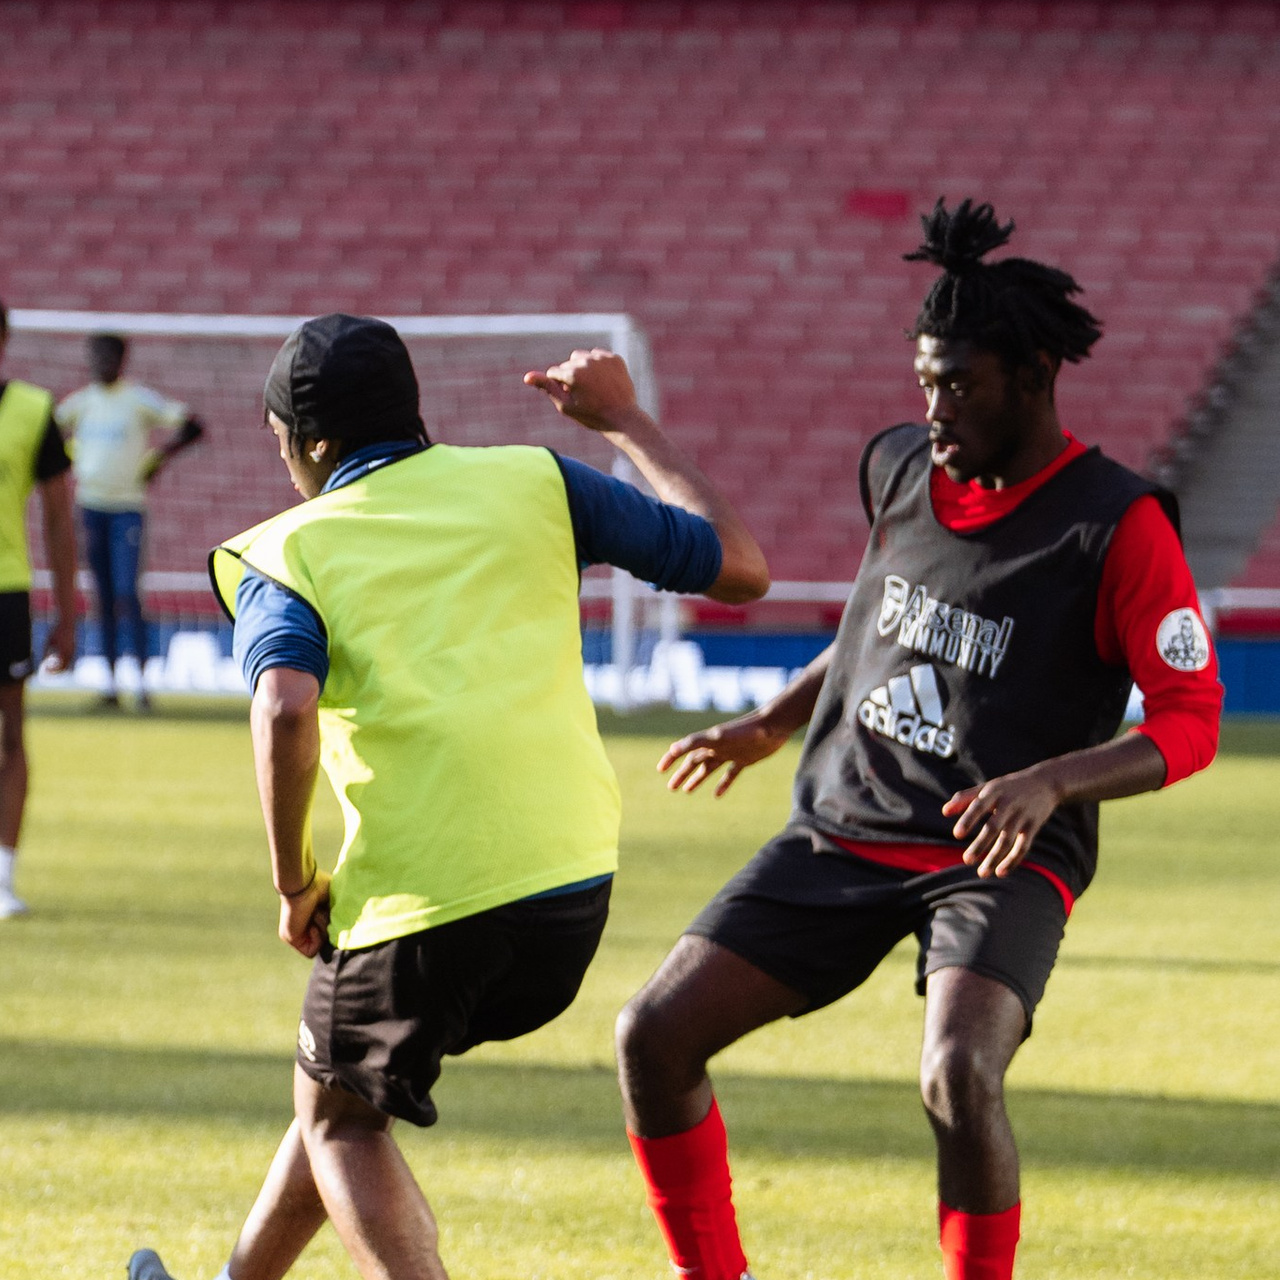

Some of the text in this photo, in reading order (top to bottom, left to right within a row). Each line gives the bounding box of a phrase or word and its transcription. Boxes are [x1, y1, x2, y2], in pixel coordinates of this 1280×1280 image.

[897, 615, 1007, 680] COMMUNITY
[904, 584, 1015, 657] Arsenal
[858, 698, 956, 759] adidas
